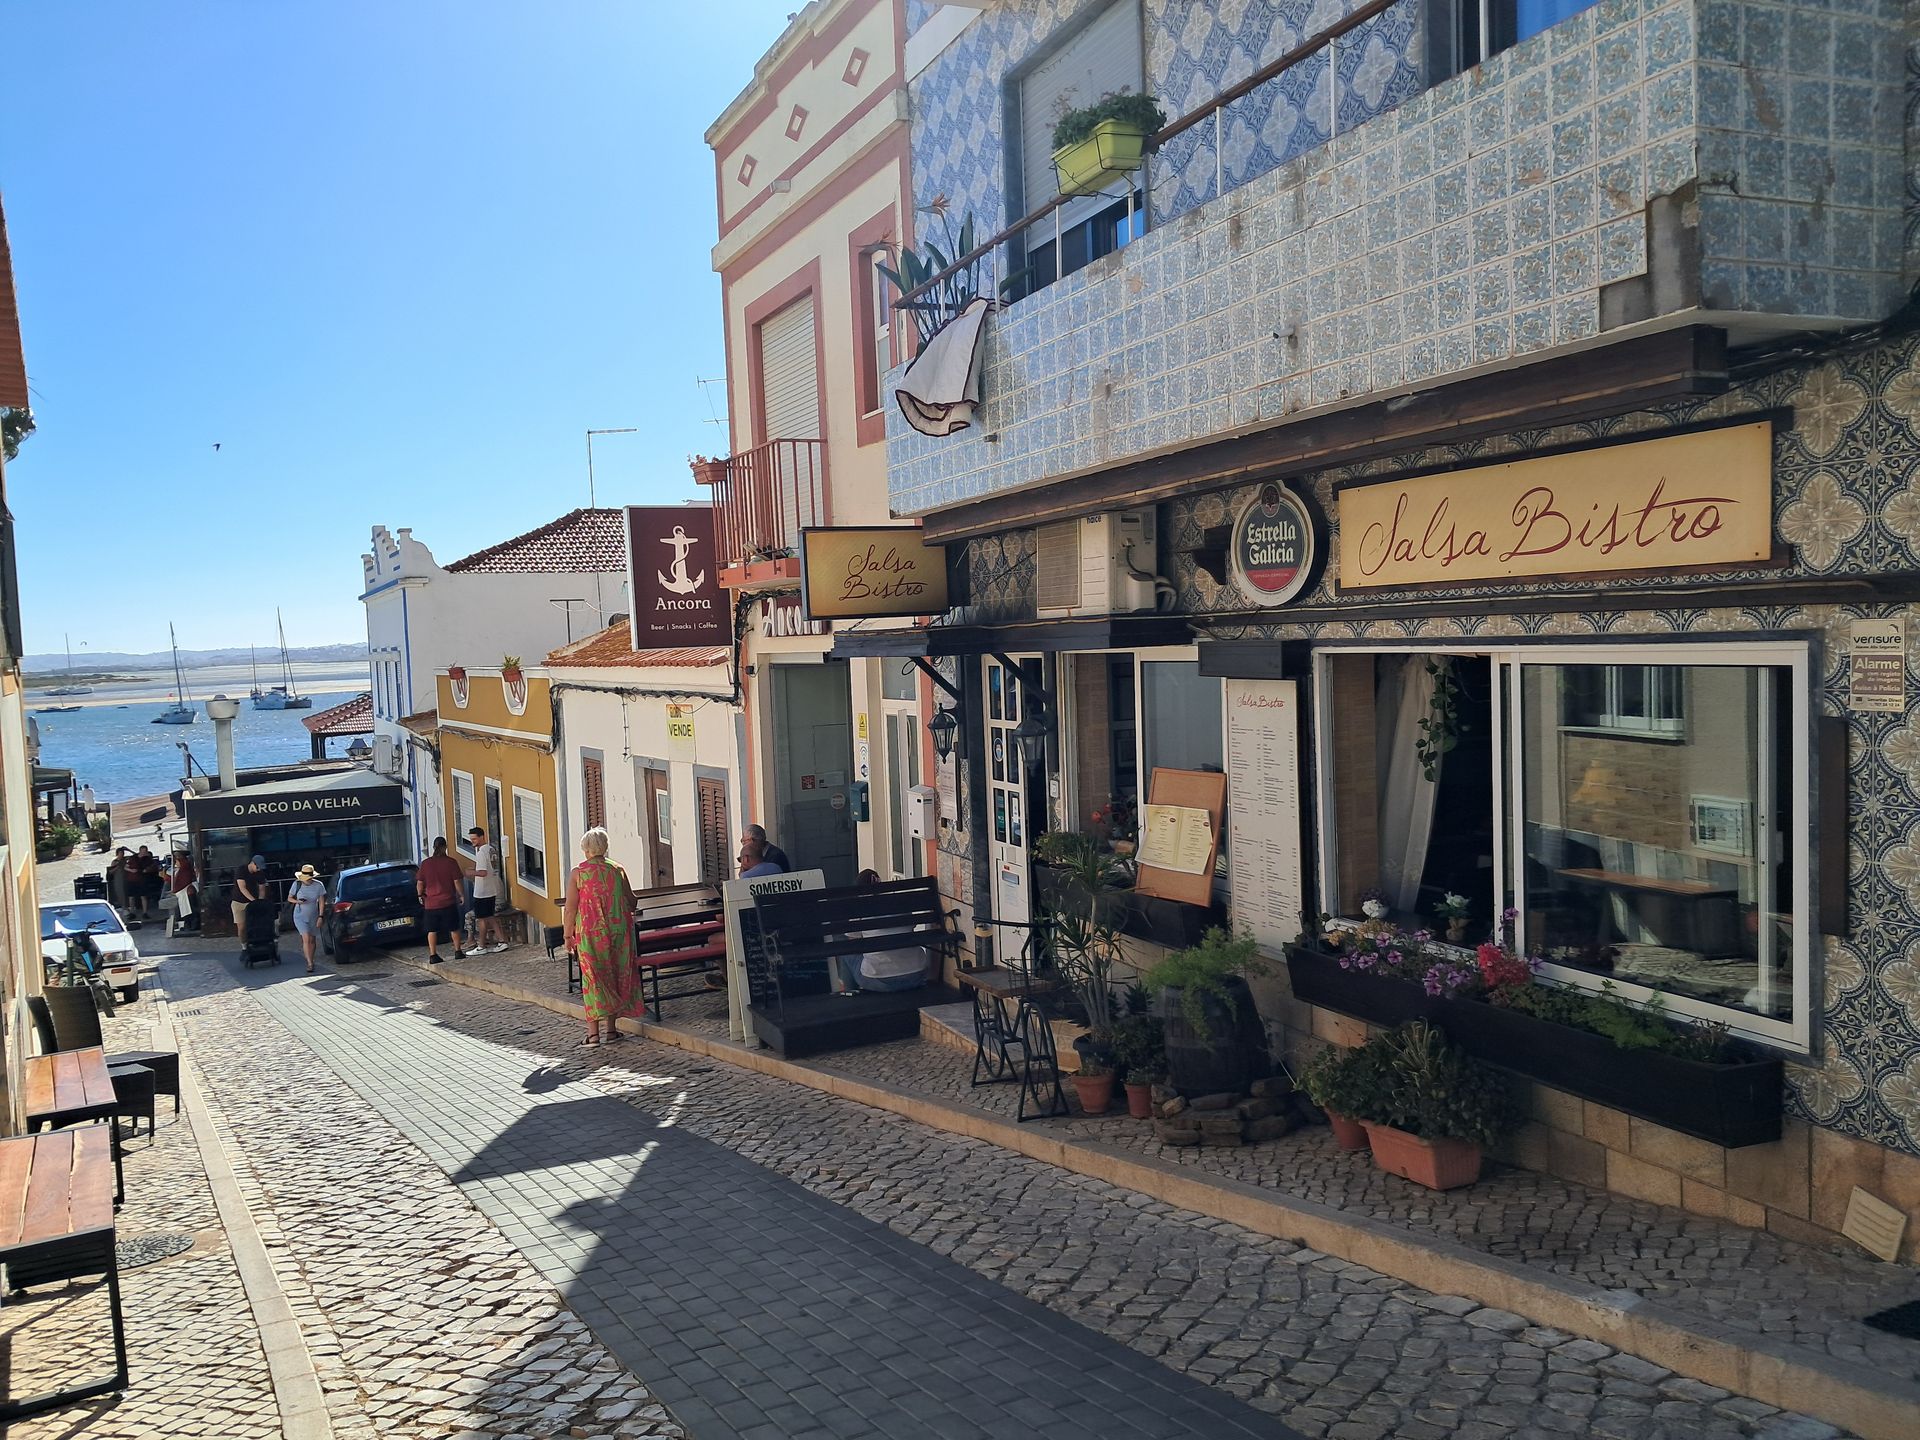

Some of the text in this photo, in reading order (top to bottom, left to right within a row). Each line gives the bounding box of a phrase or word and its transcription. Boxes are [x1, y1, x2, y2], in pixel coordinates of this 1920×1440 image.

[1247, 521, 1297, 544] Estrella
[1358, 476, 1741, 576] Salsa Bistro
[847, 544, 916, 576] Salsa
[1249, 543, 1295, 565] Galicia
[839, 574, 928, 601] Bistro
[655, 597, 712, 610] Ancora
[671, 622, 692, 630] Snacks
[698, 621, 718, 629] Coffee
[1853, 635, 1902, 644] verisure
[1855, 657, 1900, 670] Alarme
[1258, 694, 1286, 709] Bistro
[668, 723, 693, 737] VENDE
[233, 796, 360, 816] O ARCO DA VELHA
[749, 879, 803, 896] SOMERSBY
